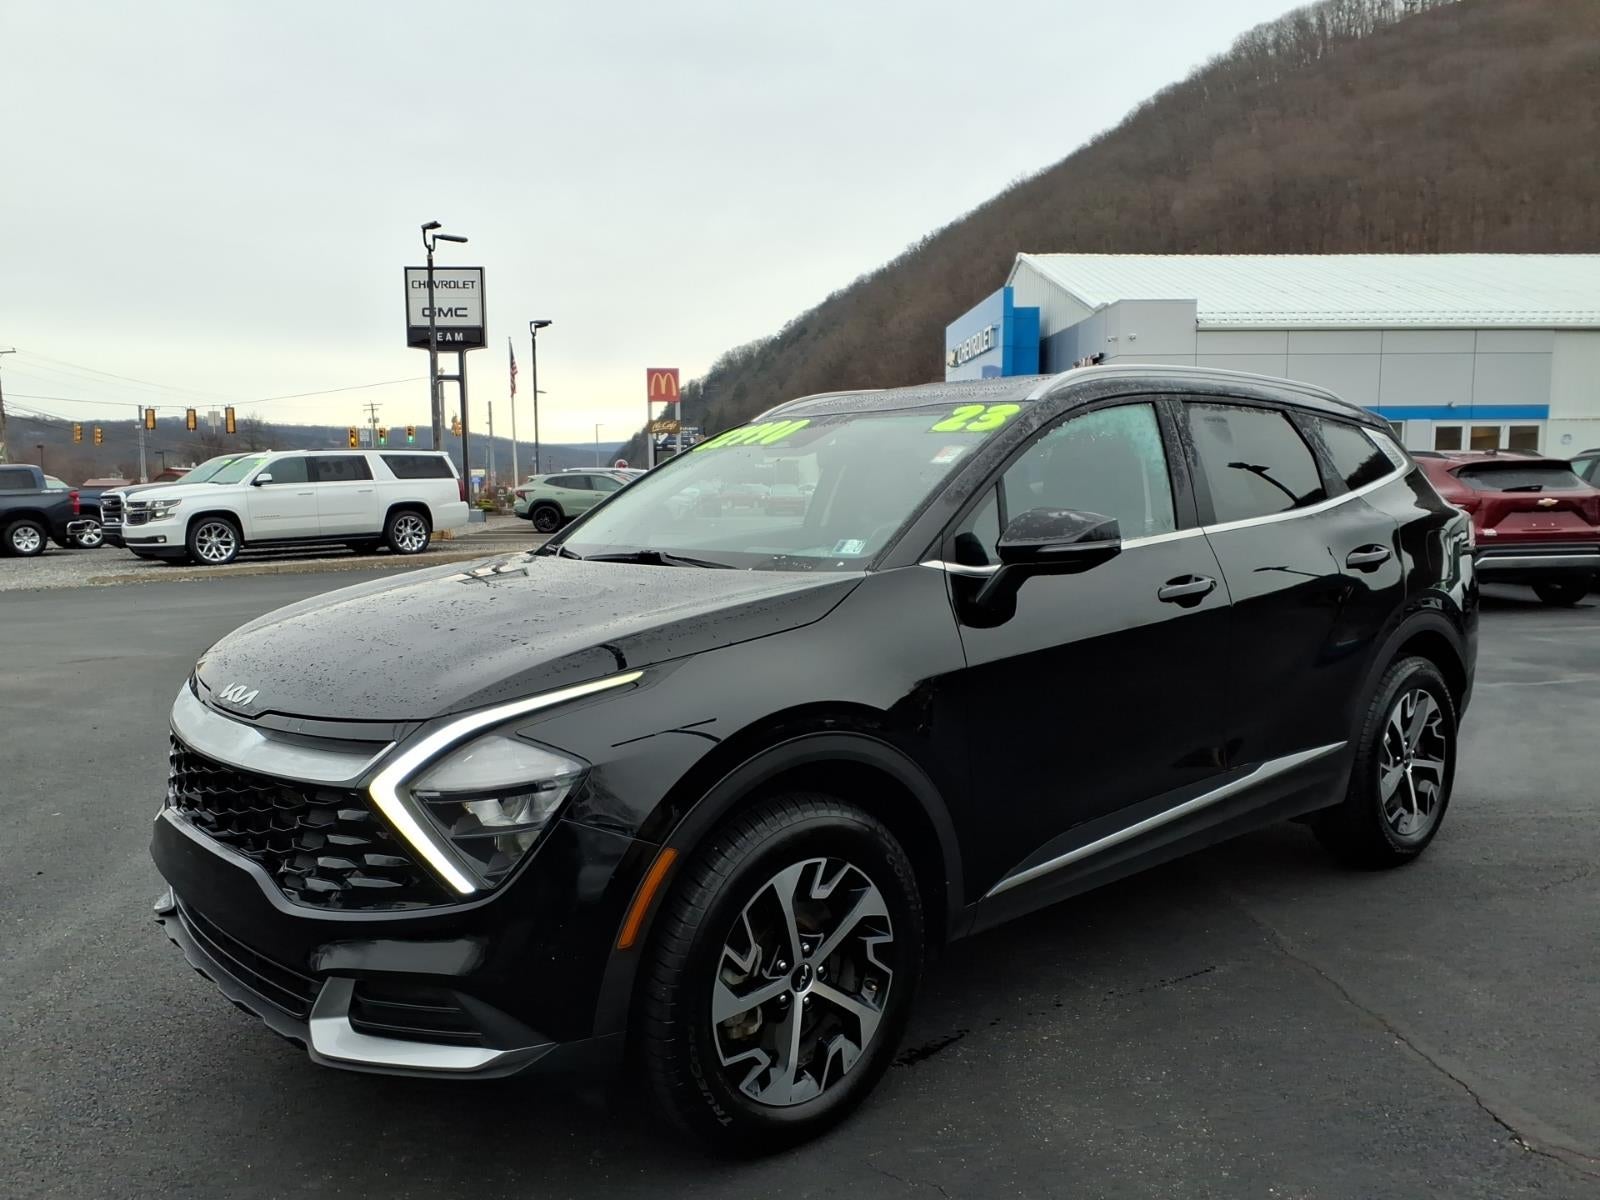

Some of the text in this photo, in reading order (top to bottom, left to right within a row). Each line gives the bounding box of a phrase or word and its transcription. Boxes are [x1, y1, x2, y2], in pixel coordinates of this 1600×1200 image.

[411, 280, 476, 289] CHVROLET
[421, 307, 468, 318] GMC
[428, 332, 464, 342] EAM
[931, 404, 1021, 432] 23
[218, 682, 260, 706] KIA
